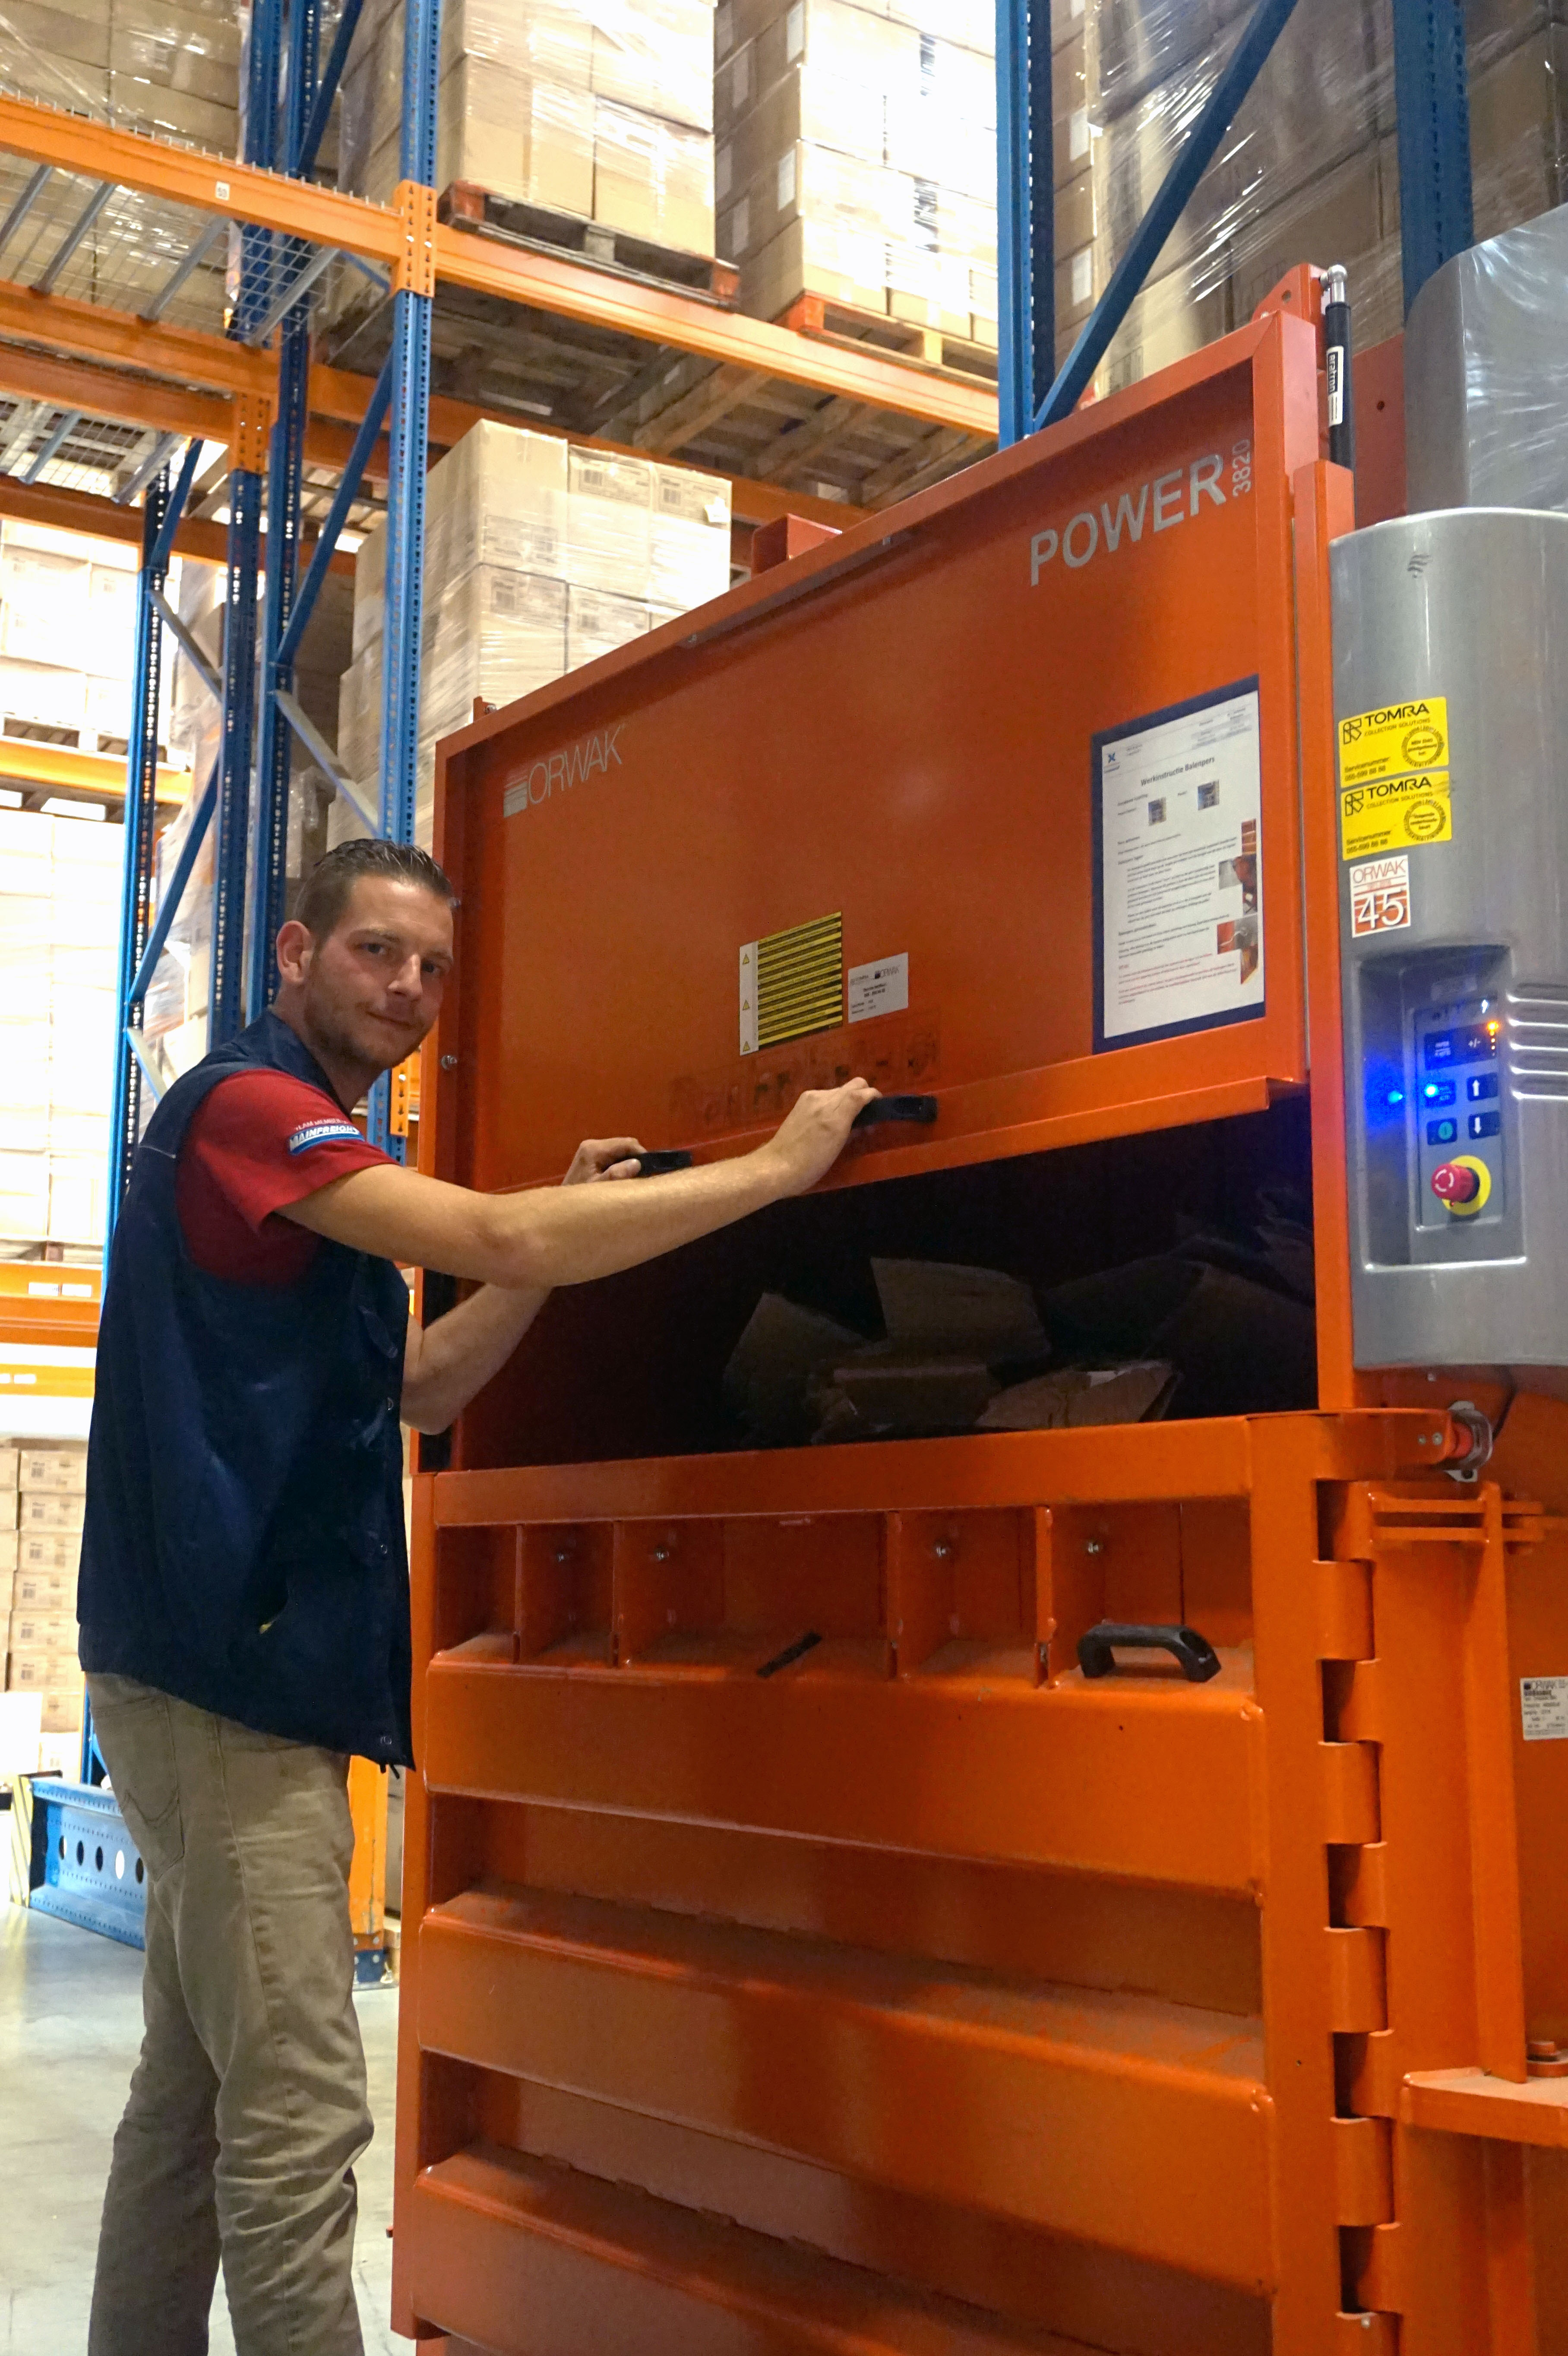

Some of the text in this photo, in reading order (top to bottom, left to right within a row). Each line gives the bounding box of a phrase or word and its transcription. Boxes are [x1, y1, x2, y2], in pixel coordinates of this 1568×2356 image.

[1232, 439, 1251, 498] 3820
[1031, 454, 1227, 587] POWER
[1365, 703, 1430, 726] TOMRA
[528, 724, 622, 804] ORWAK
[1141, 757, 1215, 786] Werkinstructie Balenpers
[1366, 776, 1432, 799] TOMRA
[1353, 858, 1407, 883] ORWAK
[1358, 890, 1404, 929] 45
